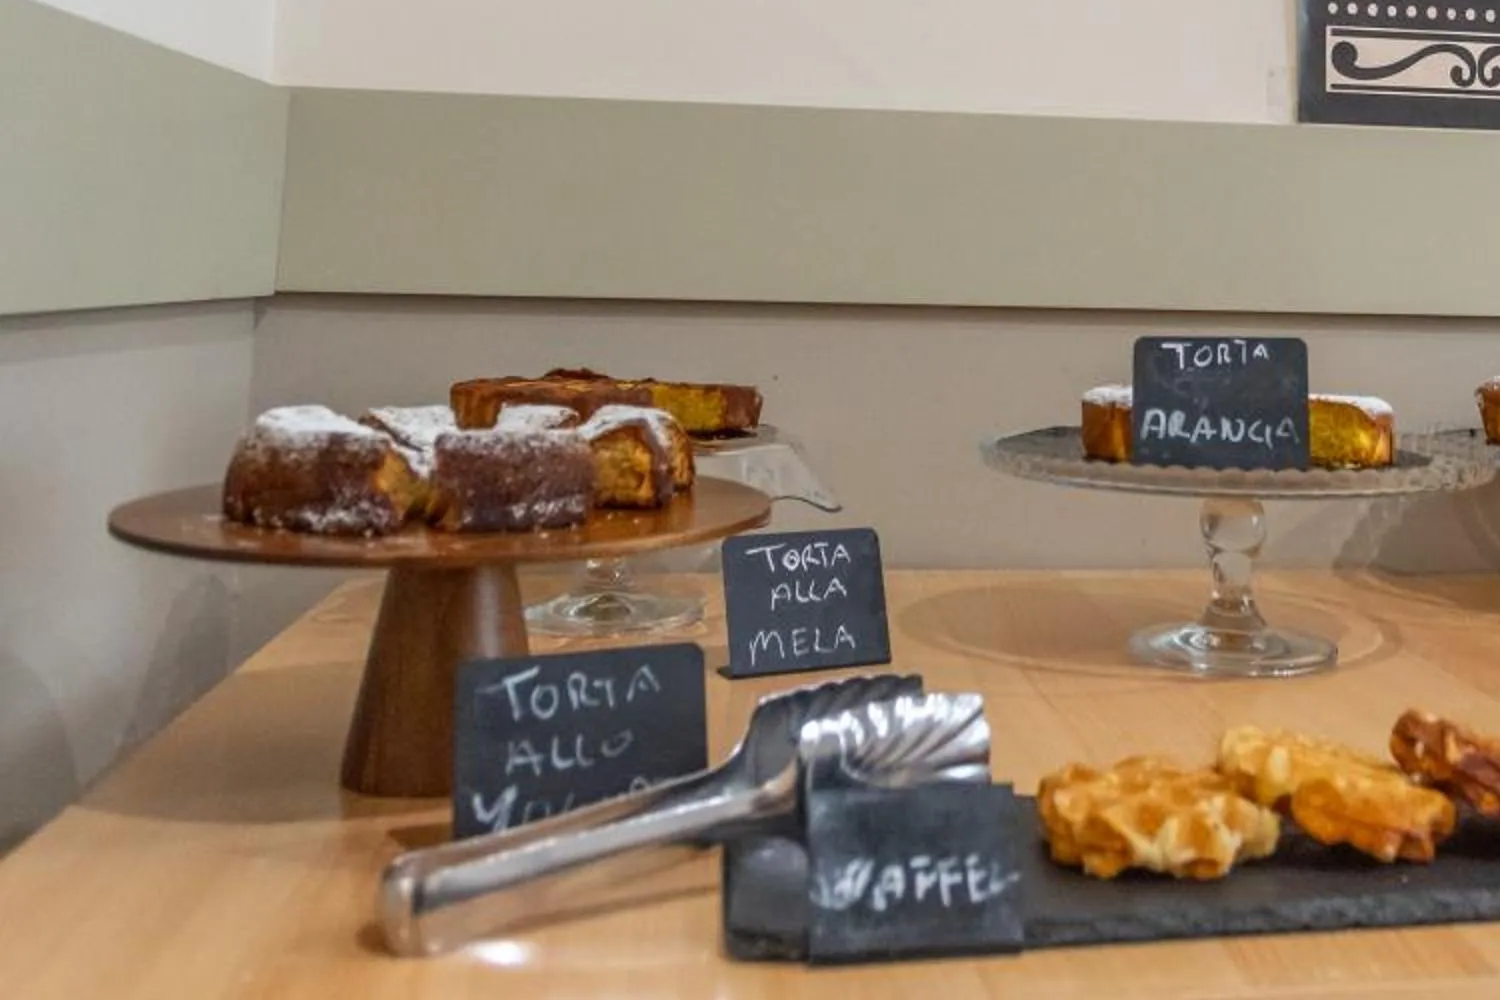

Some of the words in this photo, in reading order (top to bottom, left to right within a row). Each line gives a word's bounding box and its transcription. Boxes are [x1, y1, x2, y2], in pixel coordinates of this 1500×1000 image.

[1160, 338, 1270, 371] TORTA
[745, 541, 851, 572] TORTA
[771, 577, 847, 612] ALLA
[749, 624, 856, 667] MELA
[474, 664, 661, 722] TORTA
